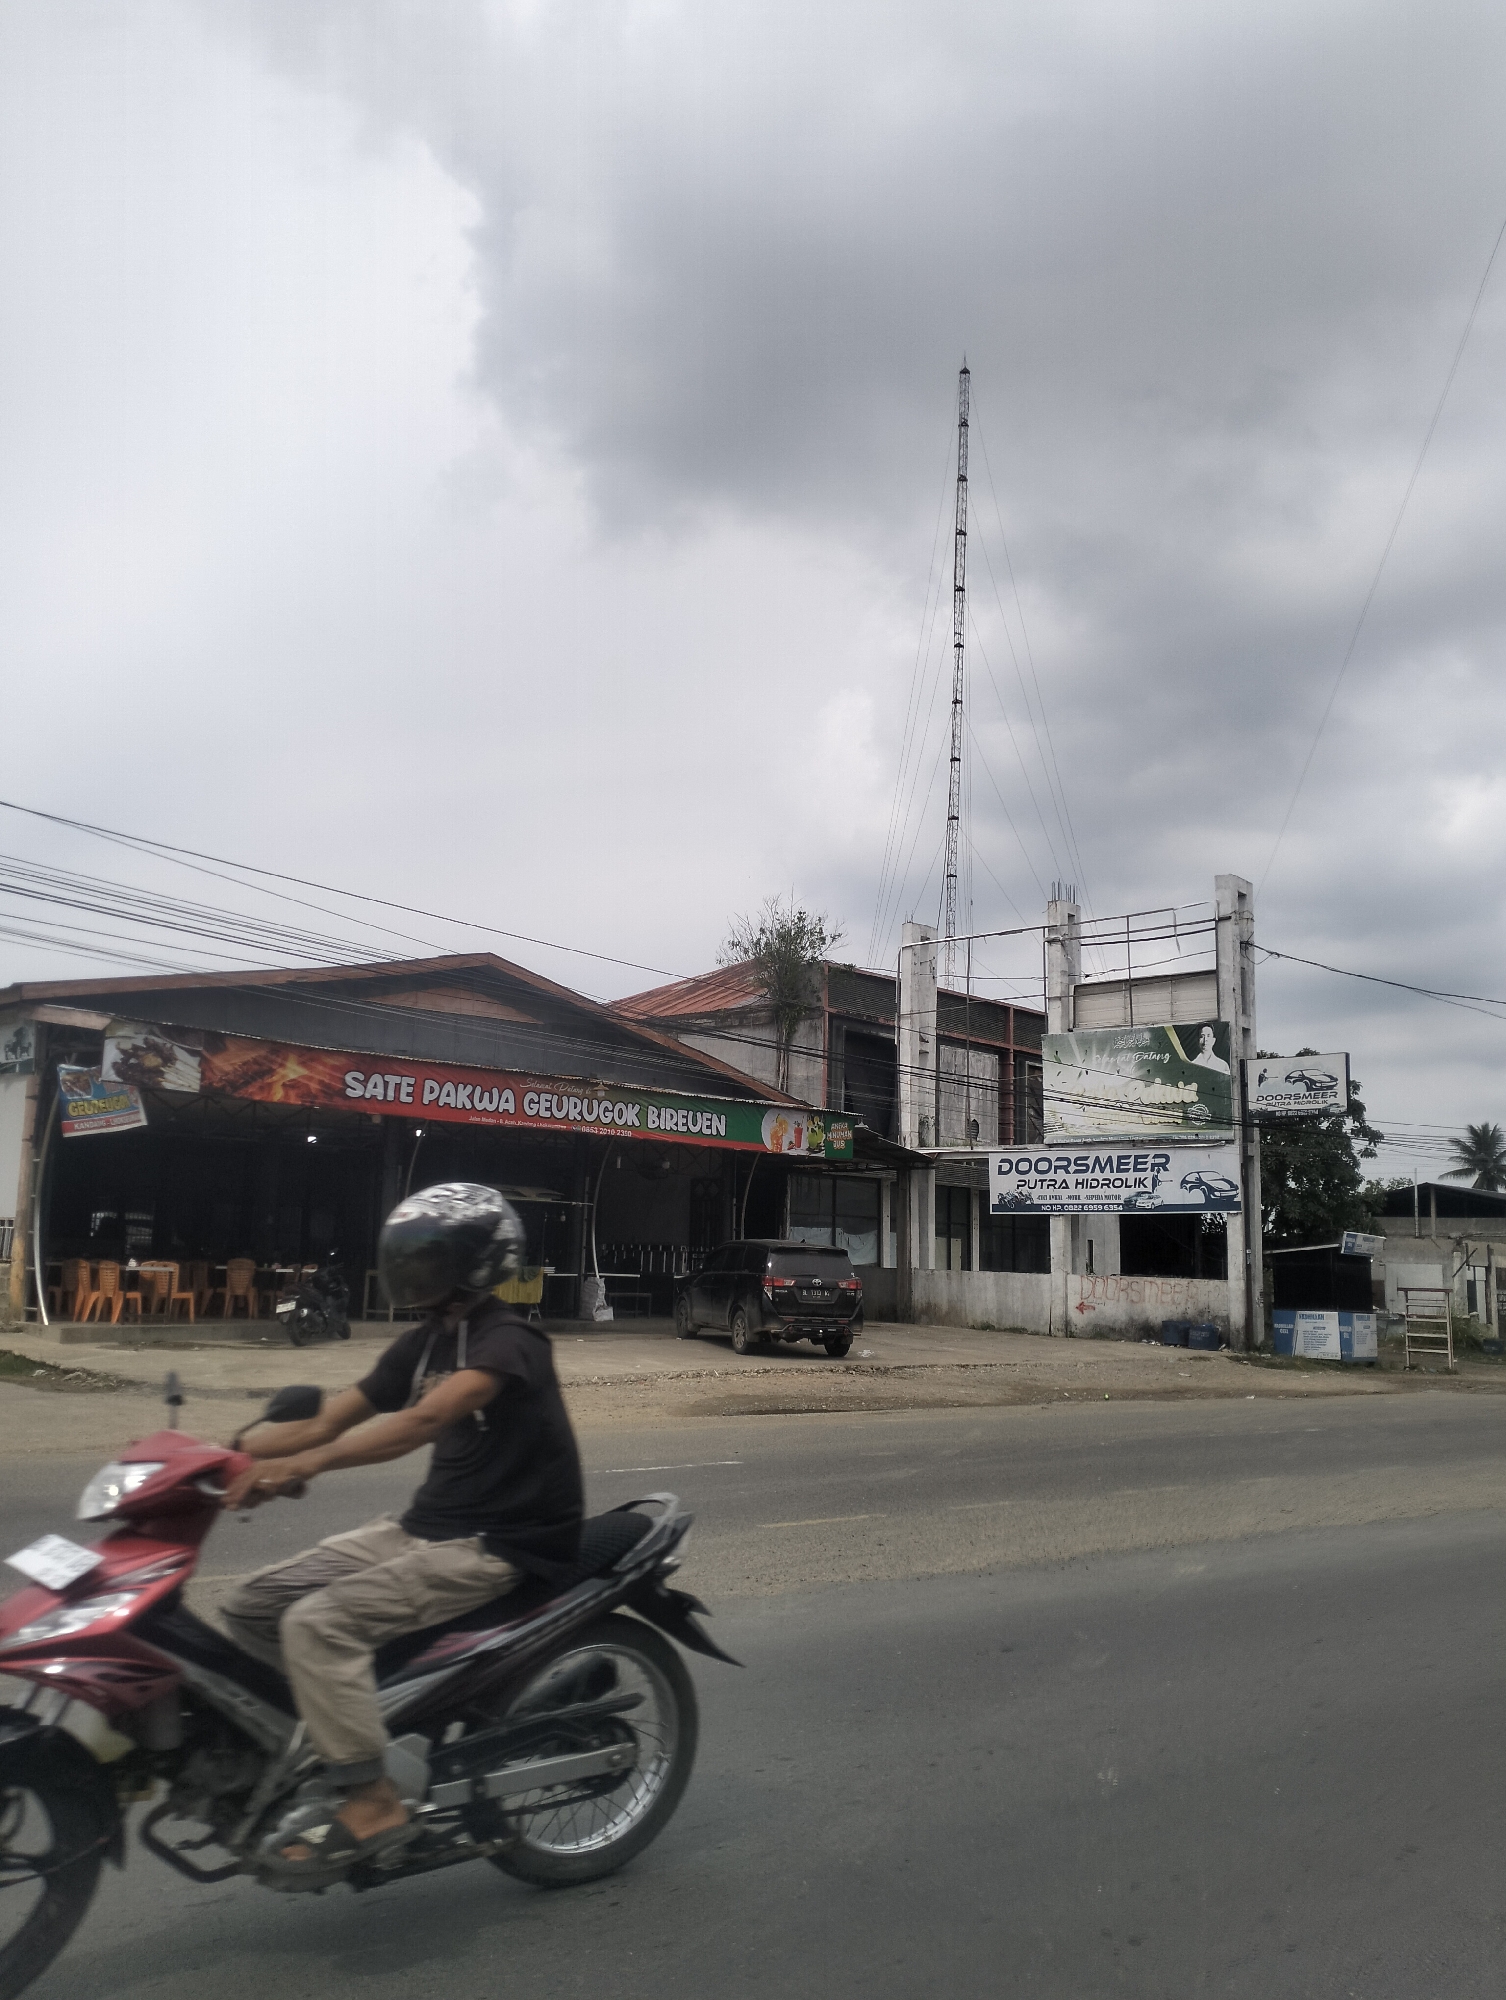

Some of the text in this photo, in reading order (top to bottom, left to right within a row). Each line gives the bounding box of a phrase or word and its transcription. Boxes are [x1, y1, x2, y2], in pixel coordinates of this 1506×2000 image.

[344, 1071, 726, 1137] SATE PAKWA GEURUGOK BIREUEN
[1256, 1091, 1338, 1102] DOORSMEER
[997, 1153, 1171, 1175] DOORSMEER
[1016, 1177, 1149, 1190] PUTRA HIDROLIK
